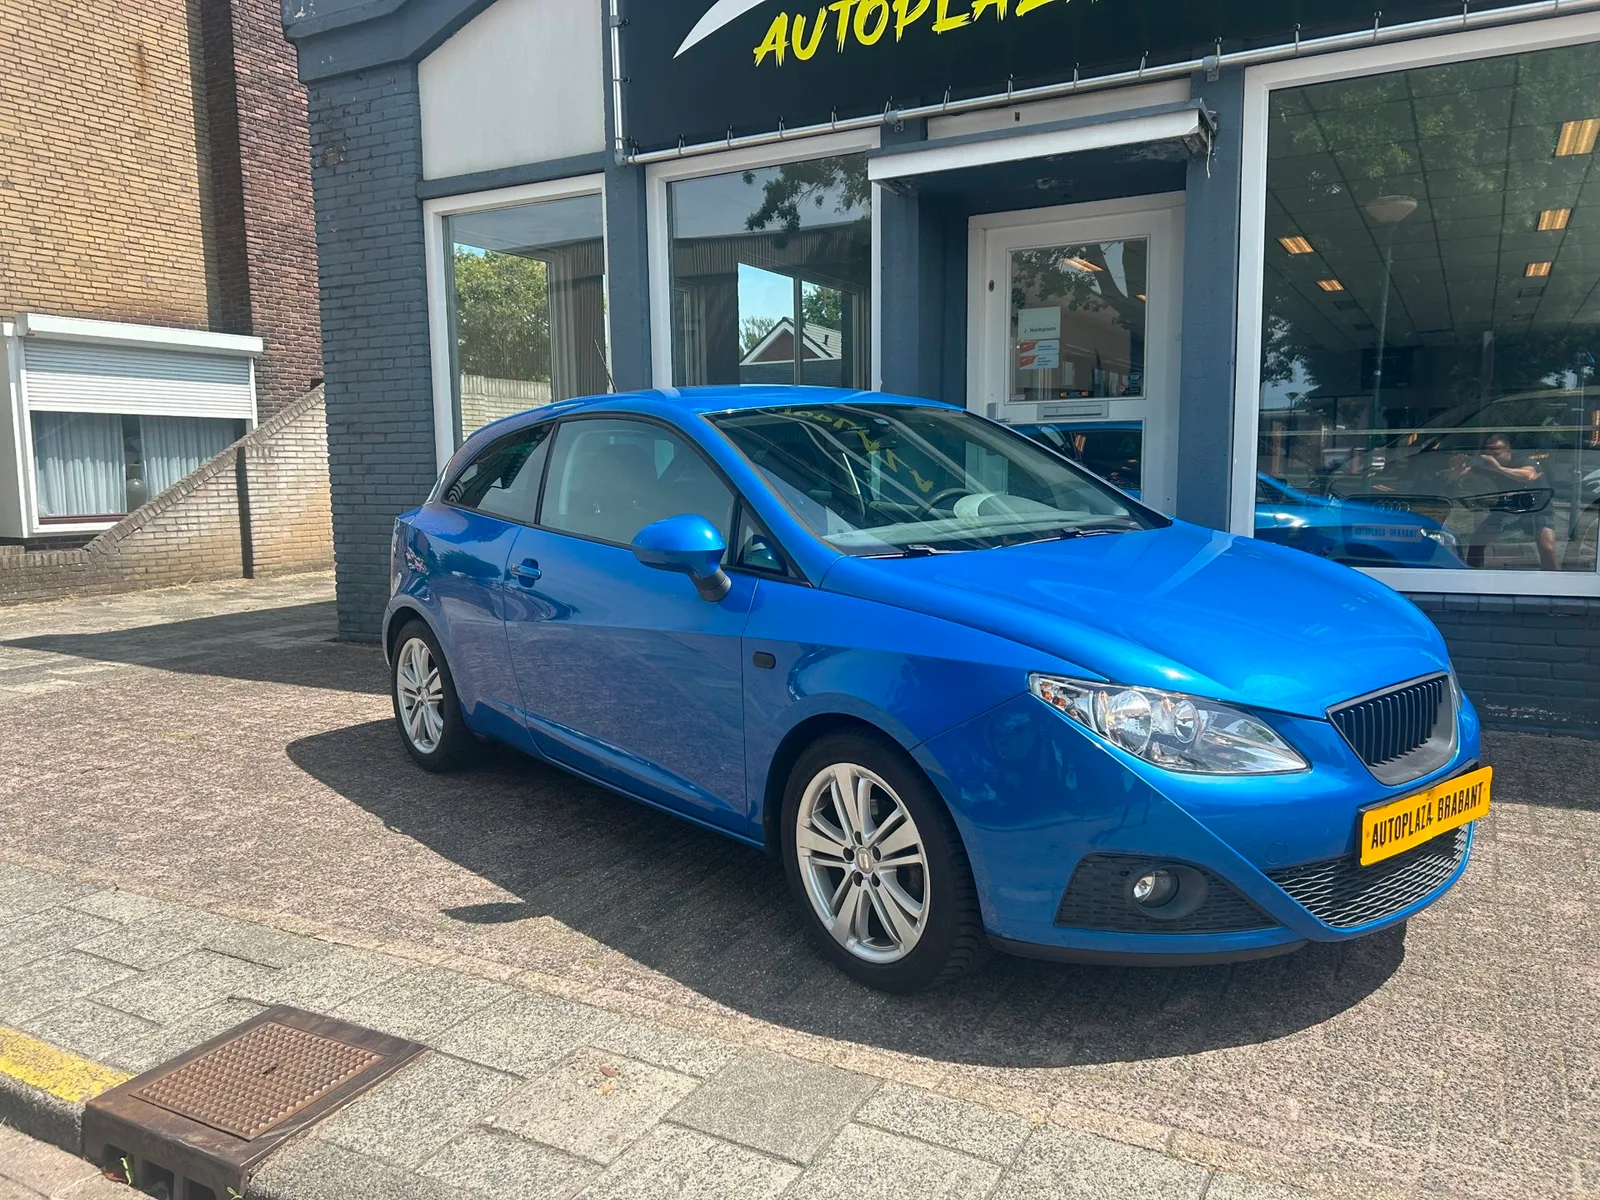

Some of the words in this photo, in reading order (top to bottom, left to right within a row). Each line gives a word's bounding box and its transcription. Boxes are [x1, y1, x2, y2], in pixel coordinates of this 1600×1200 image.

[753, 0, 1099, 68] AUTOPL
[1371, 801, 1432, 849] AUTOPLAZA
[1437, 781, 1484, 822] BRABANT
